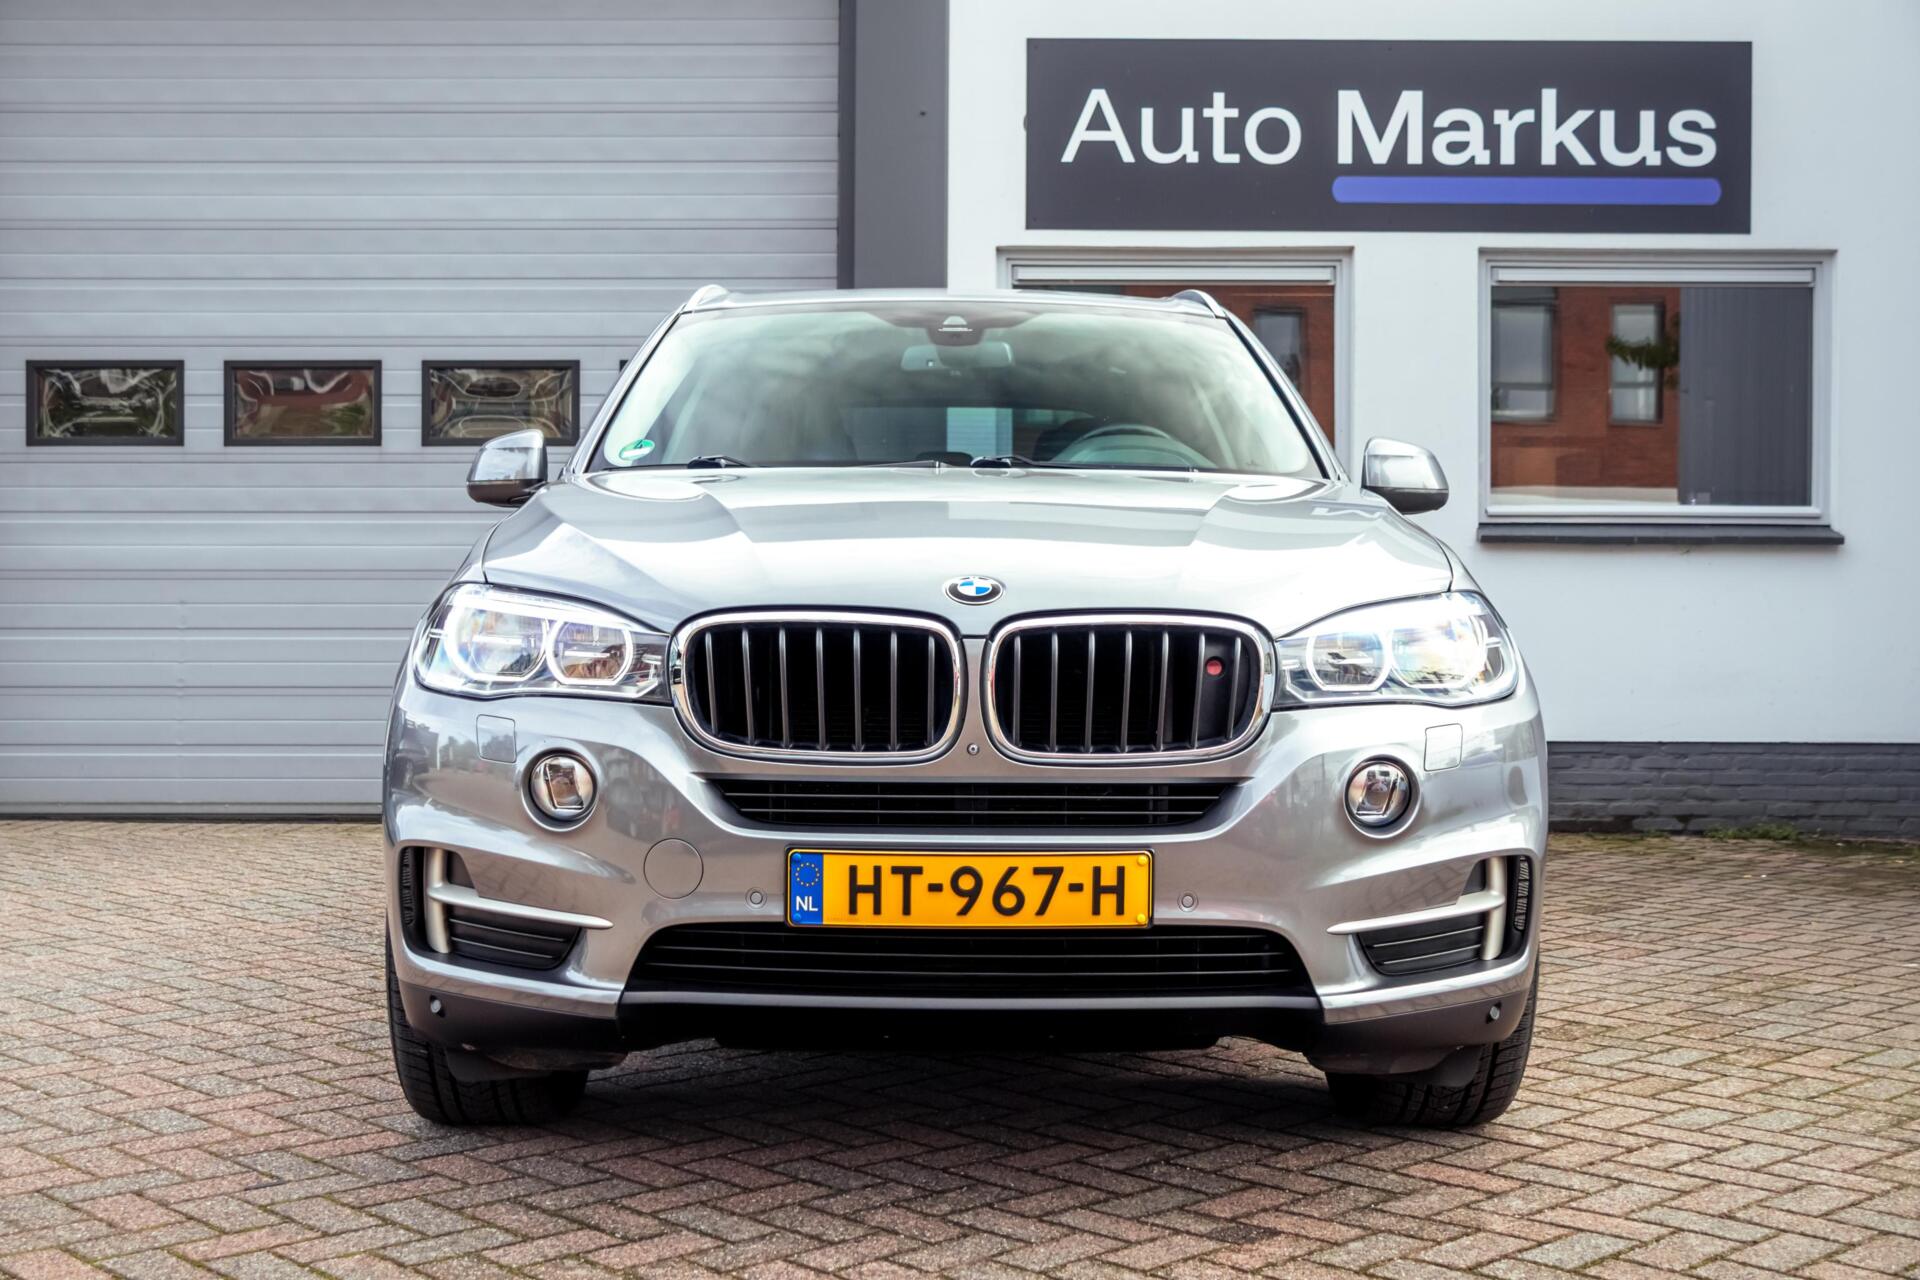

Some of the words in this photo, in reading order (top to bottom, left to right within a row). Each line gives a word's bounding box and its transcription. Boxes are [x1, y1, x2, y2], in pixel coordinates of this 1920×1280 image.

[1060, 88, 1302, 165] Auto
[1337, 88, 1717, 167] Markus
[795, 895, 819, 912] NL
[848, 864, 1126, 917] HT-967-H
